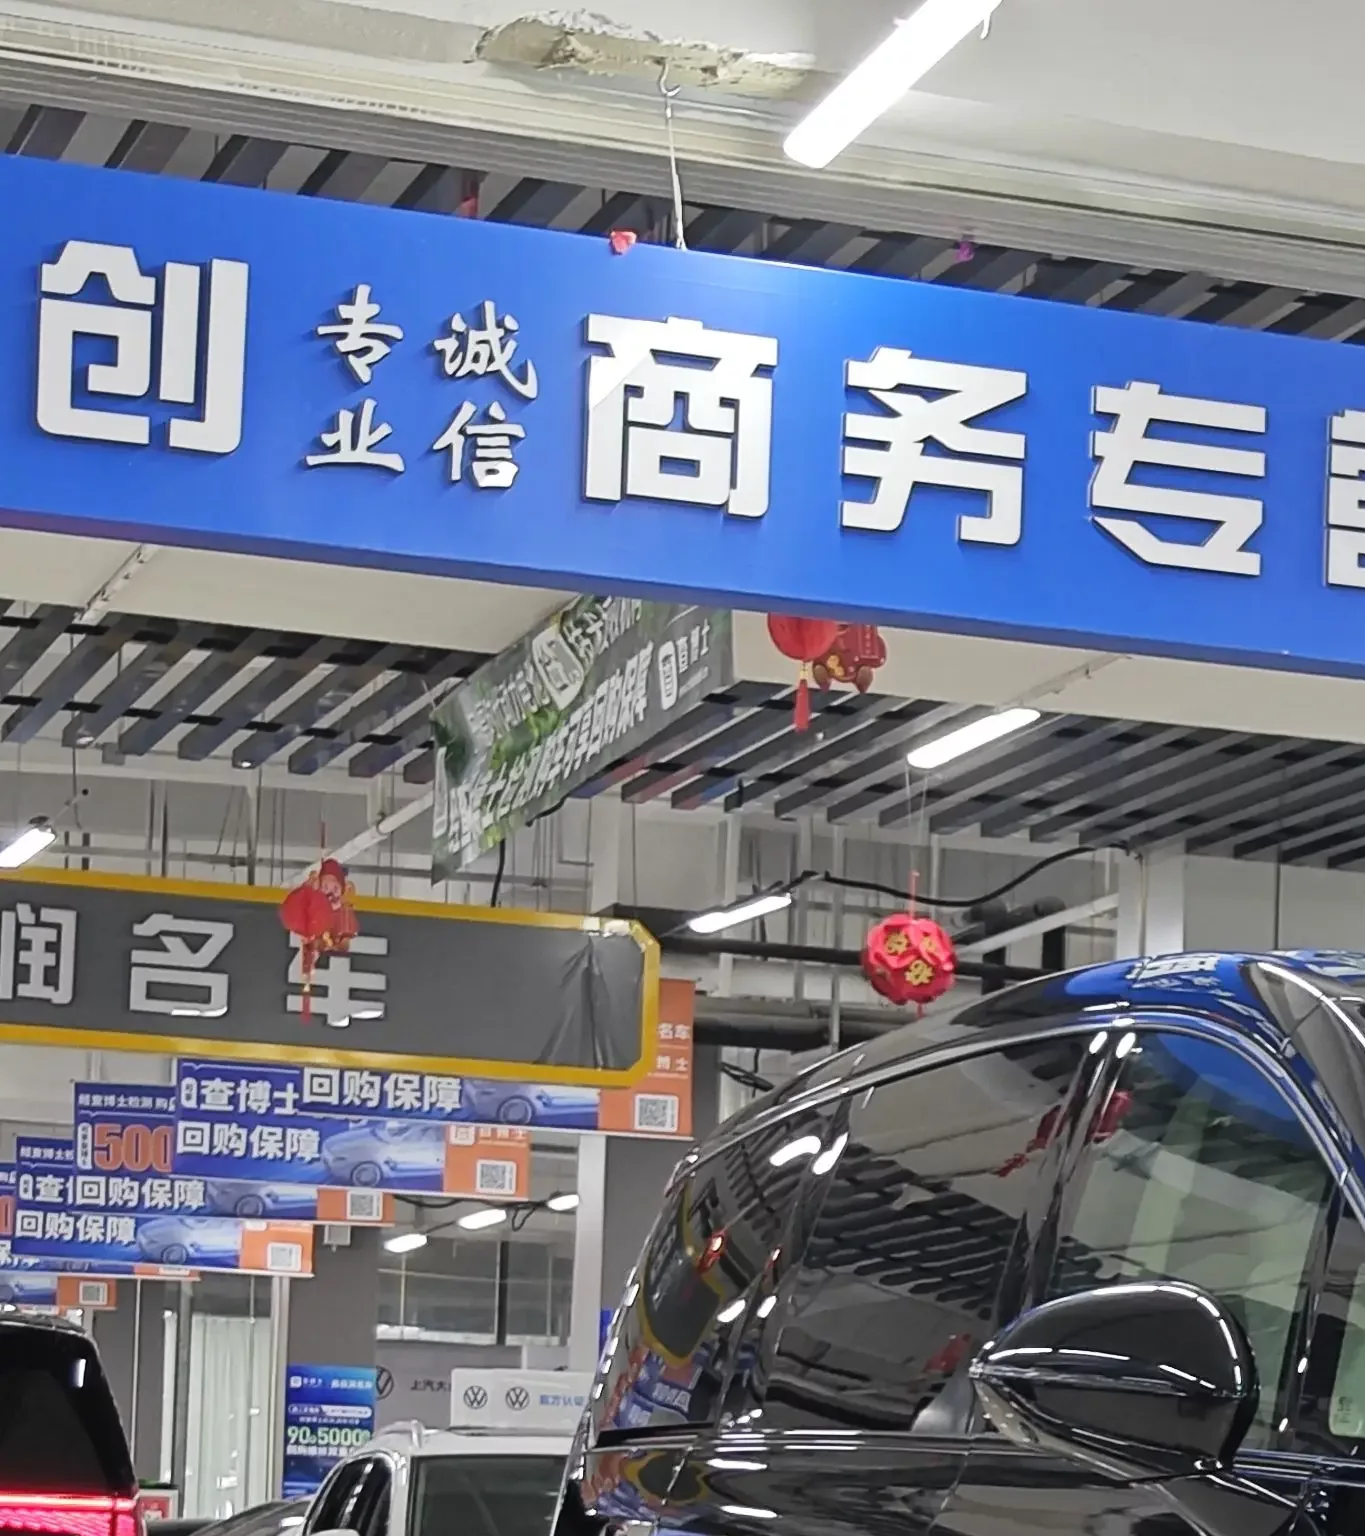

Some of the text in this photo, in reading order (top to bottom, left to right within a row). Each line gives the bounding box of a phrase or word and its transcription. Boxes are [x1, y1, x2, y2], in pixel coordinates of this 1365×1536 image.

[37, 239, 249, 454] 创
[200, 1077, 300, 1116] 查博士
[303, 1066, 463, 1113] 回购保障
[177, 1120, 321, 1162] 回购保障
[76, 1175, 206, 1211] 回购保障
[15, 1209, 137, 1246] 回购保障
[411, 1379, 450, 1392] 上汽大
